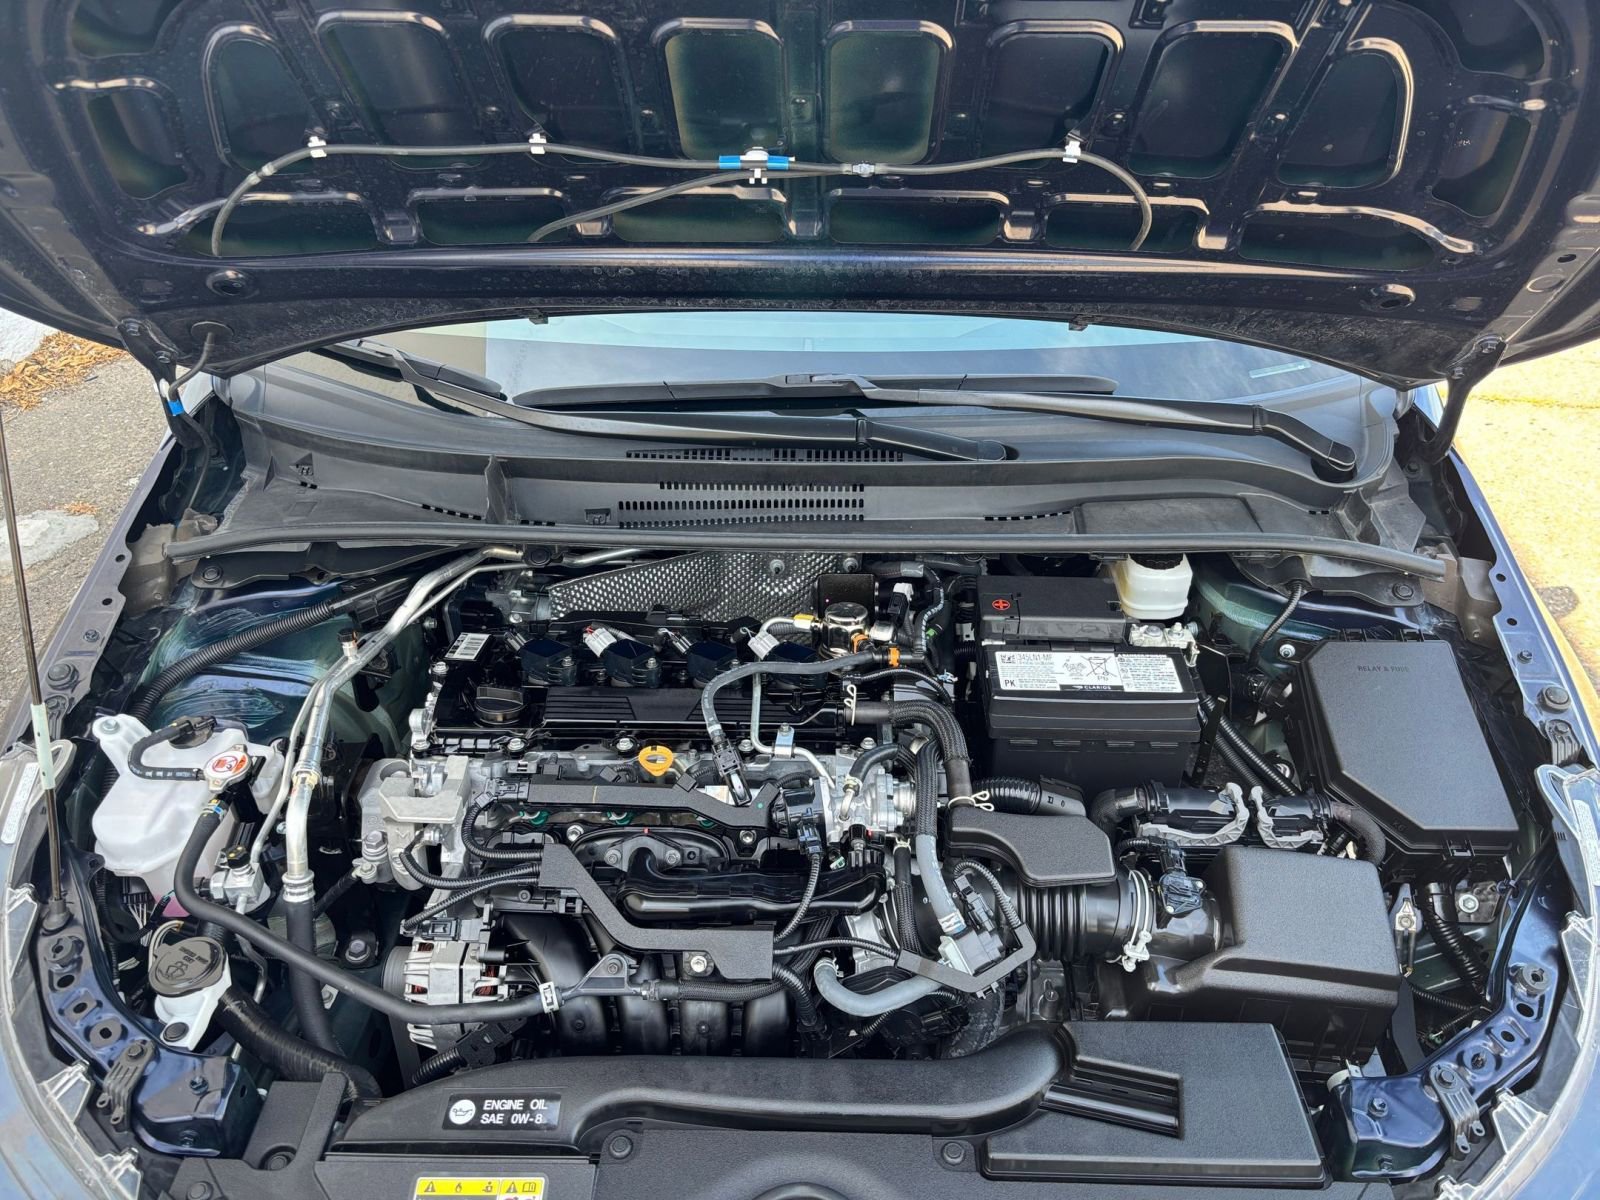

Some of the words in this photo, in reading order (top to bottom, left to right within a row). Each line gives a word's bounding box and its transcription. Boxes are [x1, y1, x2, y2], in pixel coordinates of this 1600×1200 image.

[1004, 679, 1016, 687] PK
[483, 1099, 525, 1110] ENGINE
[530, 1099, 548, 1110] OIL
[480, 1113, 505, 1124] SAE
[510, 1113, 543, 1124] 0W-8
